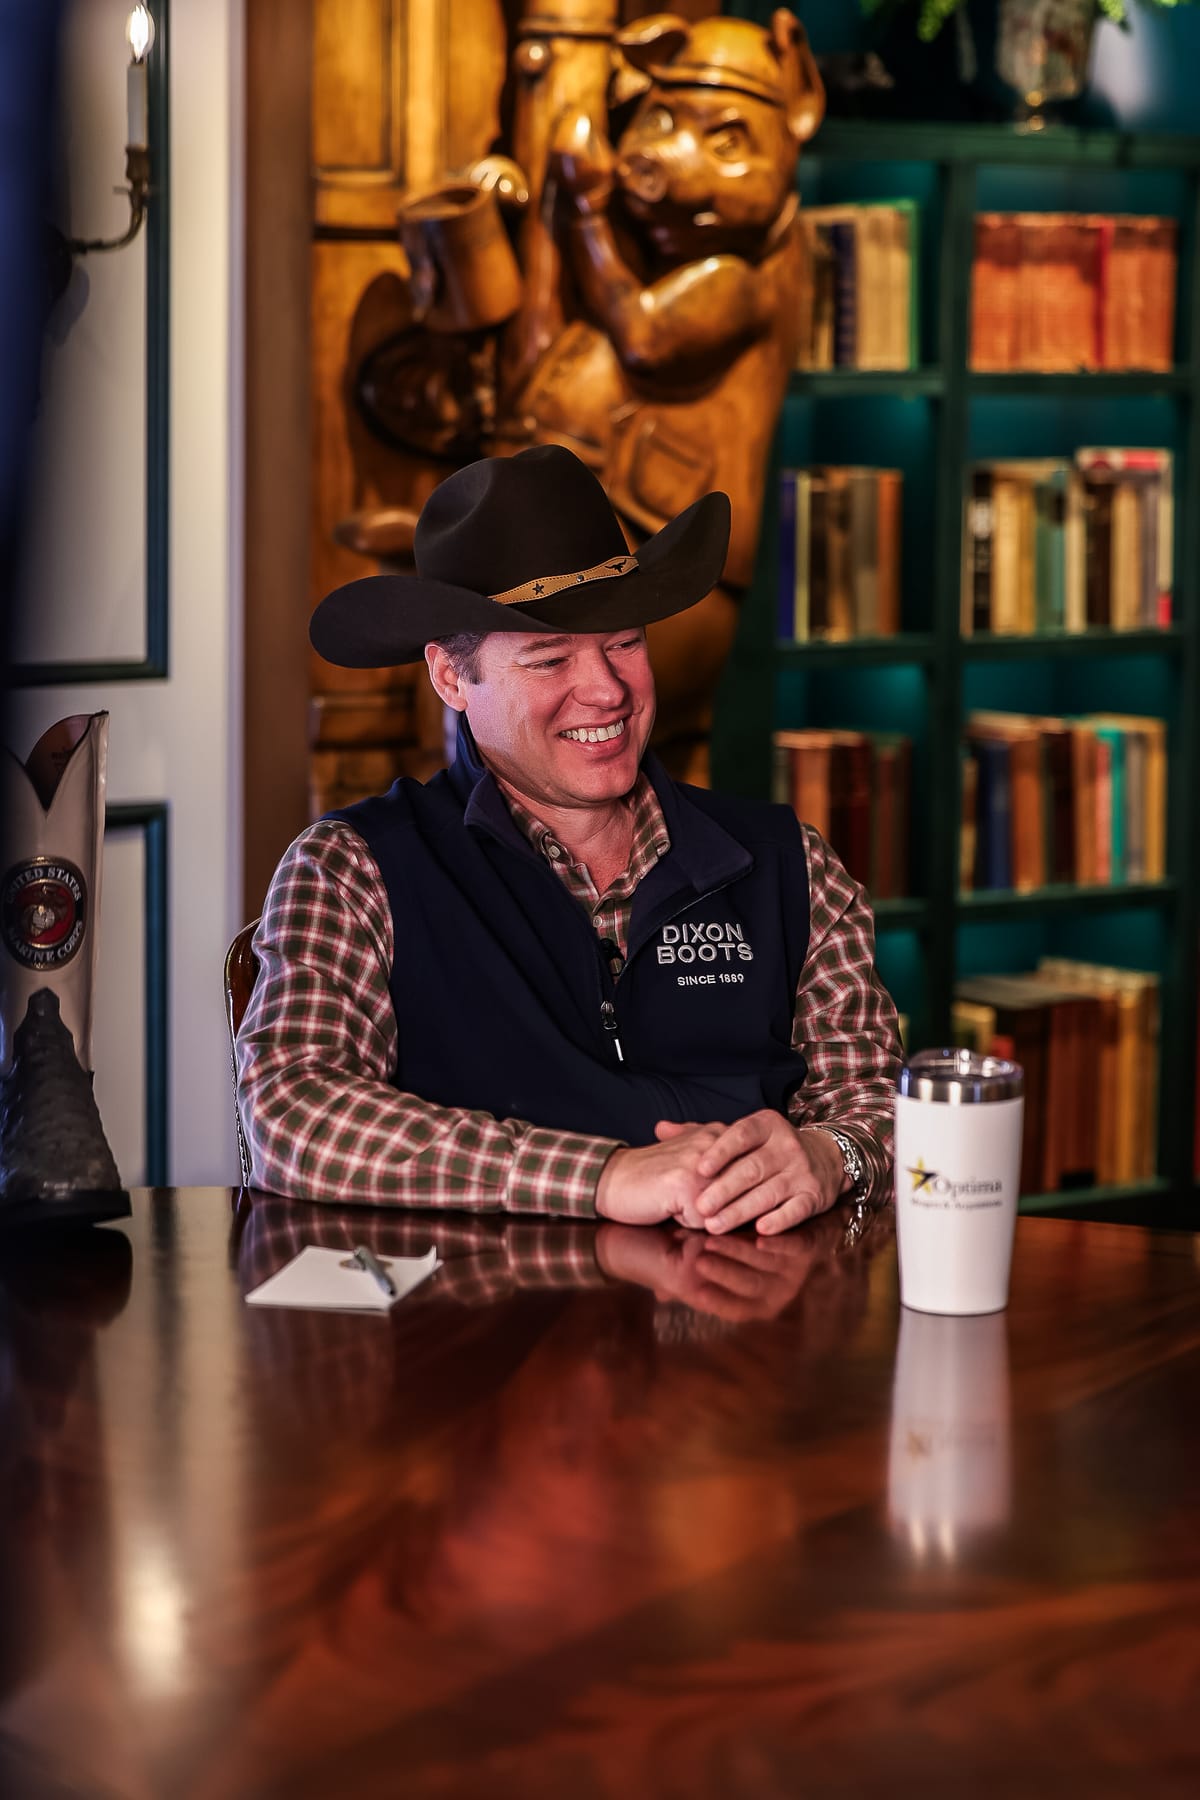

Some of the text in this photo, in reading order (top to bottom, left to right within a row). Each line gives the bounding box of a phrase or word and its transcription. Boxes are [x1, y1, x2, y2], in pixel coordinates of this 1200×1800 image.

[7, 867, 82, 904] UNITED STATES
[8, 920, 83, 961] MARINE CORPS
[662, 922, 744, 944] DIXON
[656, 942, 754, 965] BOOTS
[677, 973, 745, 986] SINCE 1889
[933, 1176, 1003, 1199] Optima
